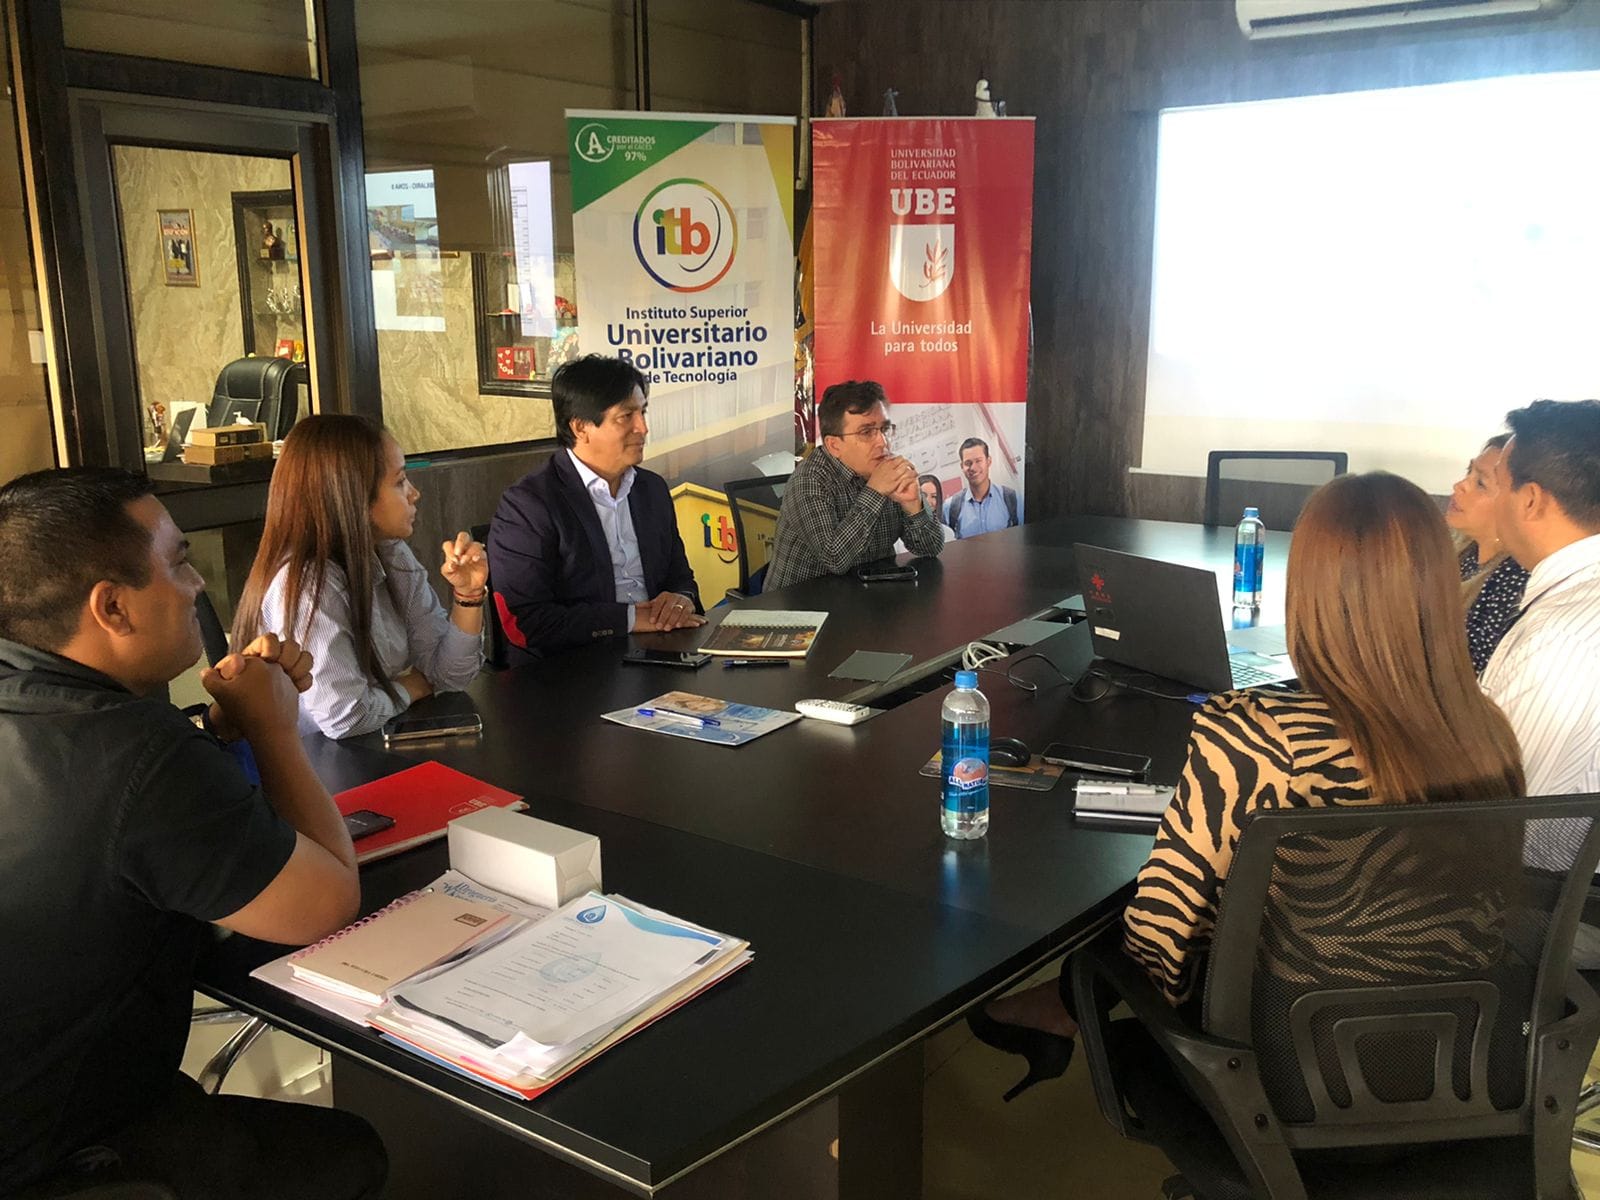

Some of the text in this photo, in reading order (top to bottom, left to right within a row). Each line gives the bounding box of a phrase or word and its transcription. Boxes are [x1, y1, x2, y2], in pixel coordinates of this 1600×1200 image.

[624, 151, 647, 162] 97%
[890, 148, 956, 158] UNIVERSIDAD
[890, 160, 956, 169] BOLIVARIANA
[890, 170, 956, 180] DEL ECUADOR
[890, 187, 956, 216] UBE
[652, 207, 711, 255] itb
[626, 305, 749, 321] Instituto Superior
[607, 321, 768, 346] Universitario
[871, 320, 972, 335] La Universidad
[884, 338, 958, 357] para todos
[617, 346, 759, 370] Bolivariano
[663, 369, 738, 385] Tecnología
[701, 513, 738, 552] itb
